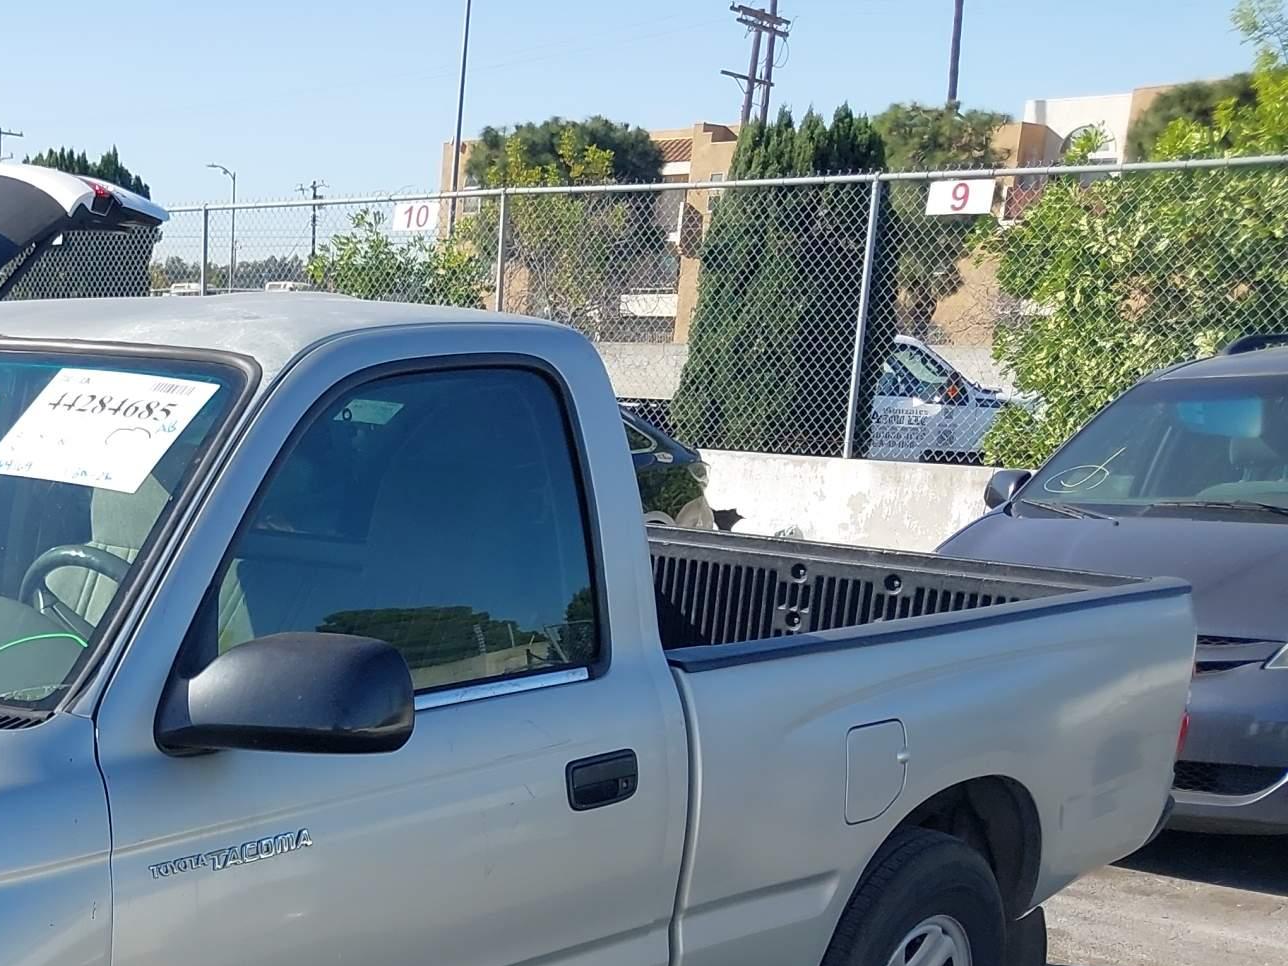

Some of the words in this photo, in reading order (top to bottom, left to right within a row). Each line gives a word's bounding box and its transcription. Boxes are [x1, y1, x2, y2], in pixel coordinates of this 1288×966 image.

[950, 182, 970, 212] 9
[404, 204, 429, 229] 10
[48, 391, 179, 422] 44284685
[148, 853, 209, 879] TOYOTA
[209, 827, 313, 871] TACOMA
